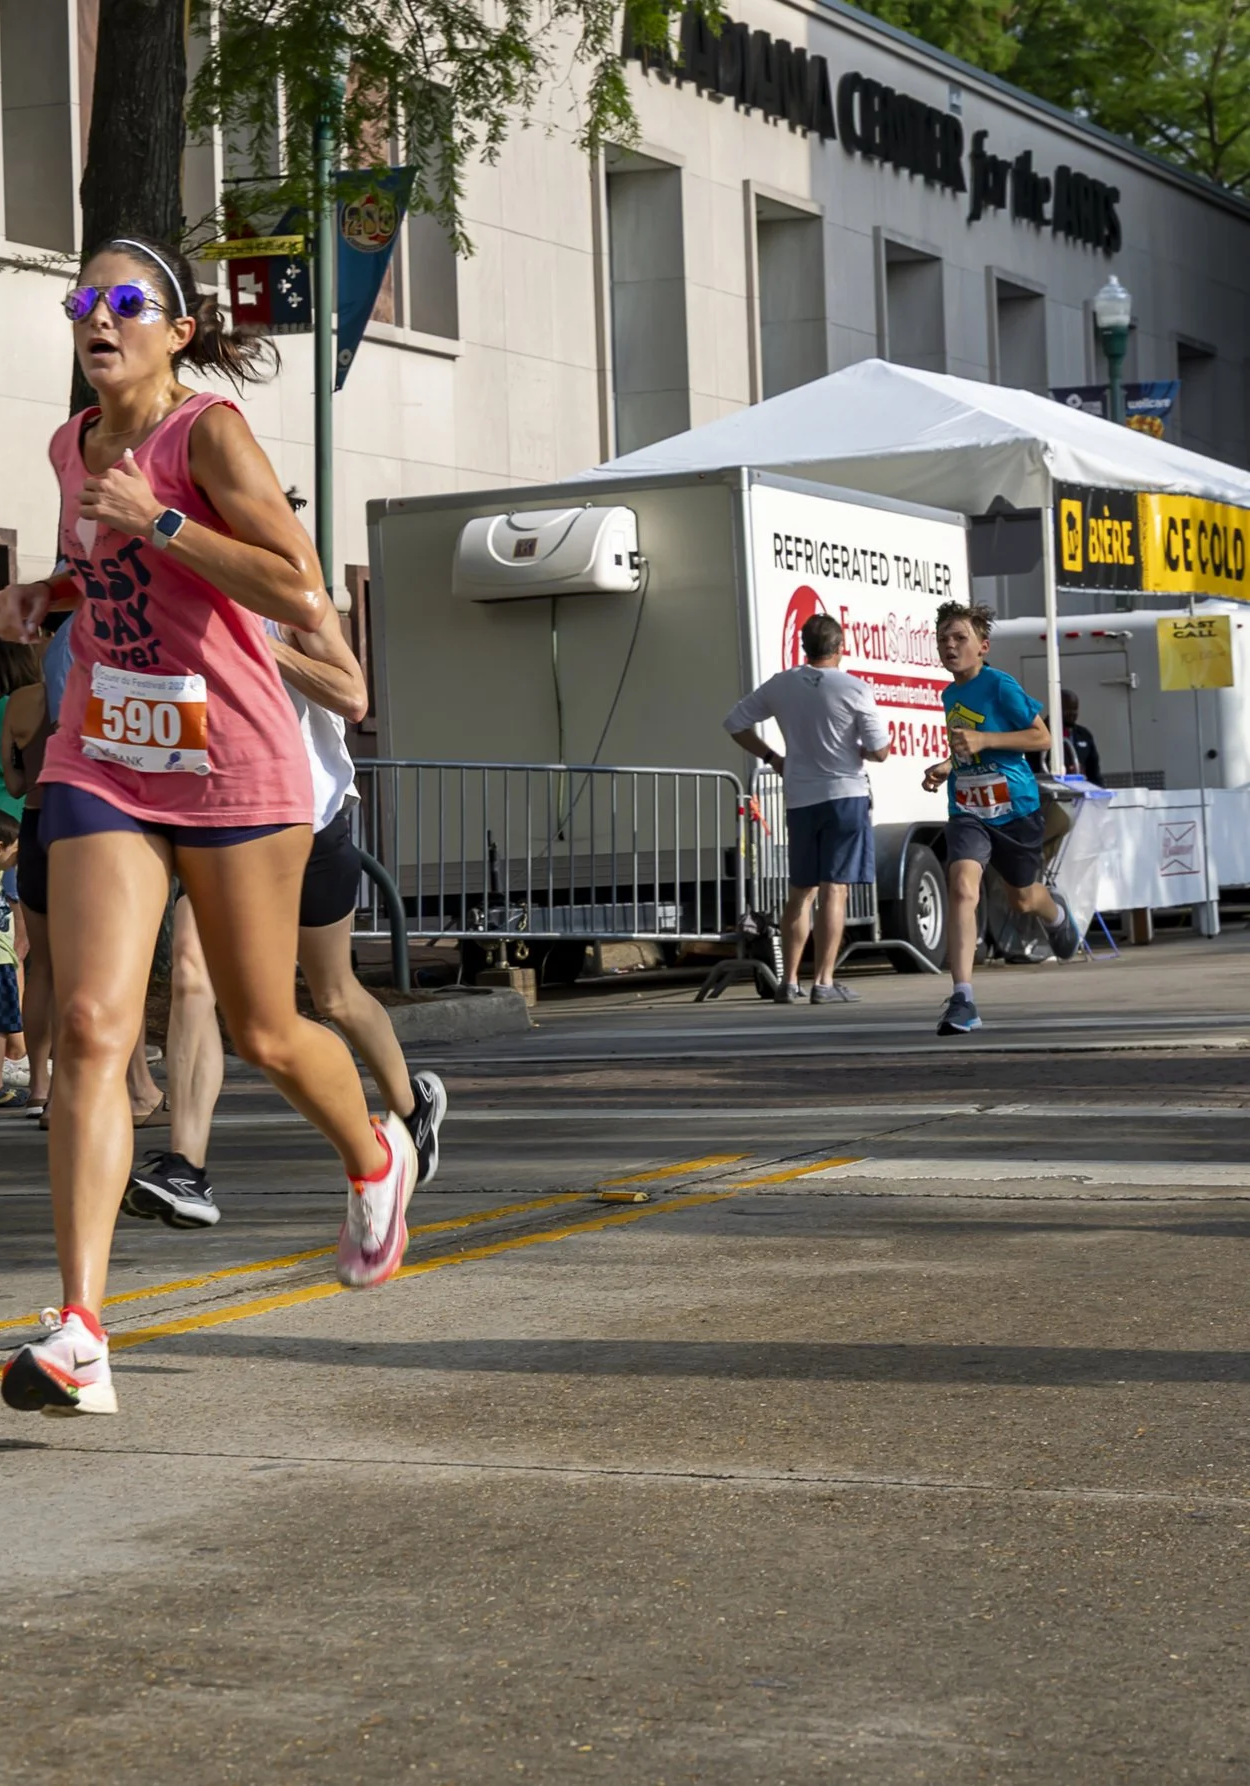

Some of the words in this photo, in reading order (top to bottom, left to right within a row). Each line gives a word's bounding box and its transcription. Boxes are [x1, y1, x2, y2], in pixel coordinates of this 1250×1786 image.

[837, 71, 967, 199] CENTER
[966, 129, 1011, 229] for
[1010, 149, 1052, 236] the
[1051, 164, 1122, 260] ARTS
[773, 532, 890, 587] REFRIGERATED
[893, 554, 953, 597] TRAILER
[1088, 504, 1135, 565] BIÈRE
[1161, 515, 1193, 573] CE
[1197, 519, 1245, 581] COLD
[839, 605, 946, 668] EventSolutio
[1173, 620, 1216, 630] LAST
[1173, 630, 1218, 639] CALL
[102, 699, 182, 747] 590
[888, 720, 950, 759] 261-245
[962, 785, 997, 806] 211
